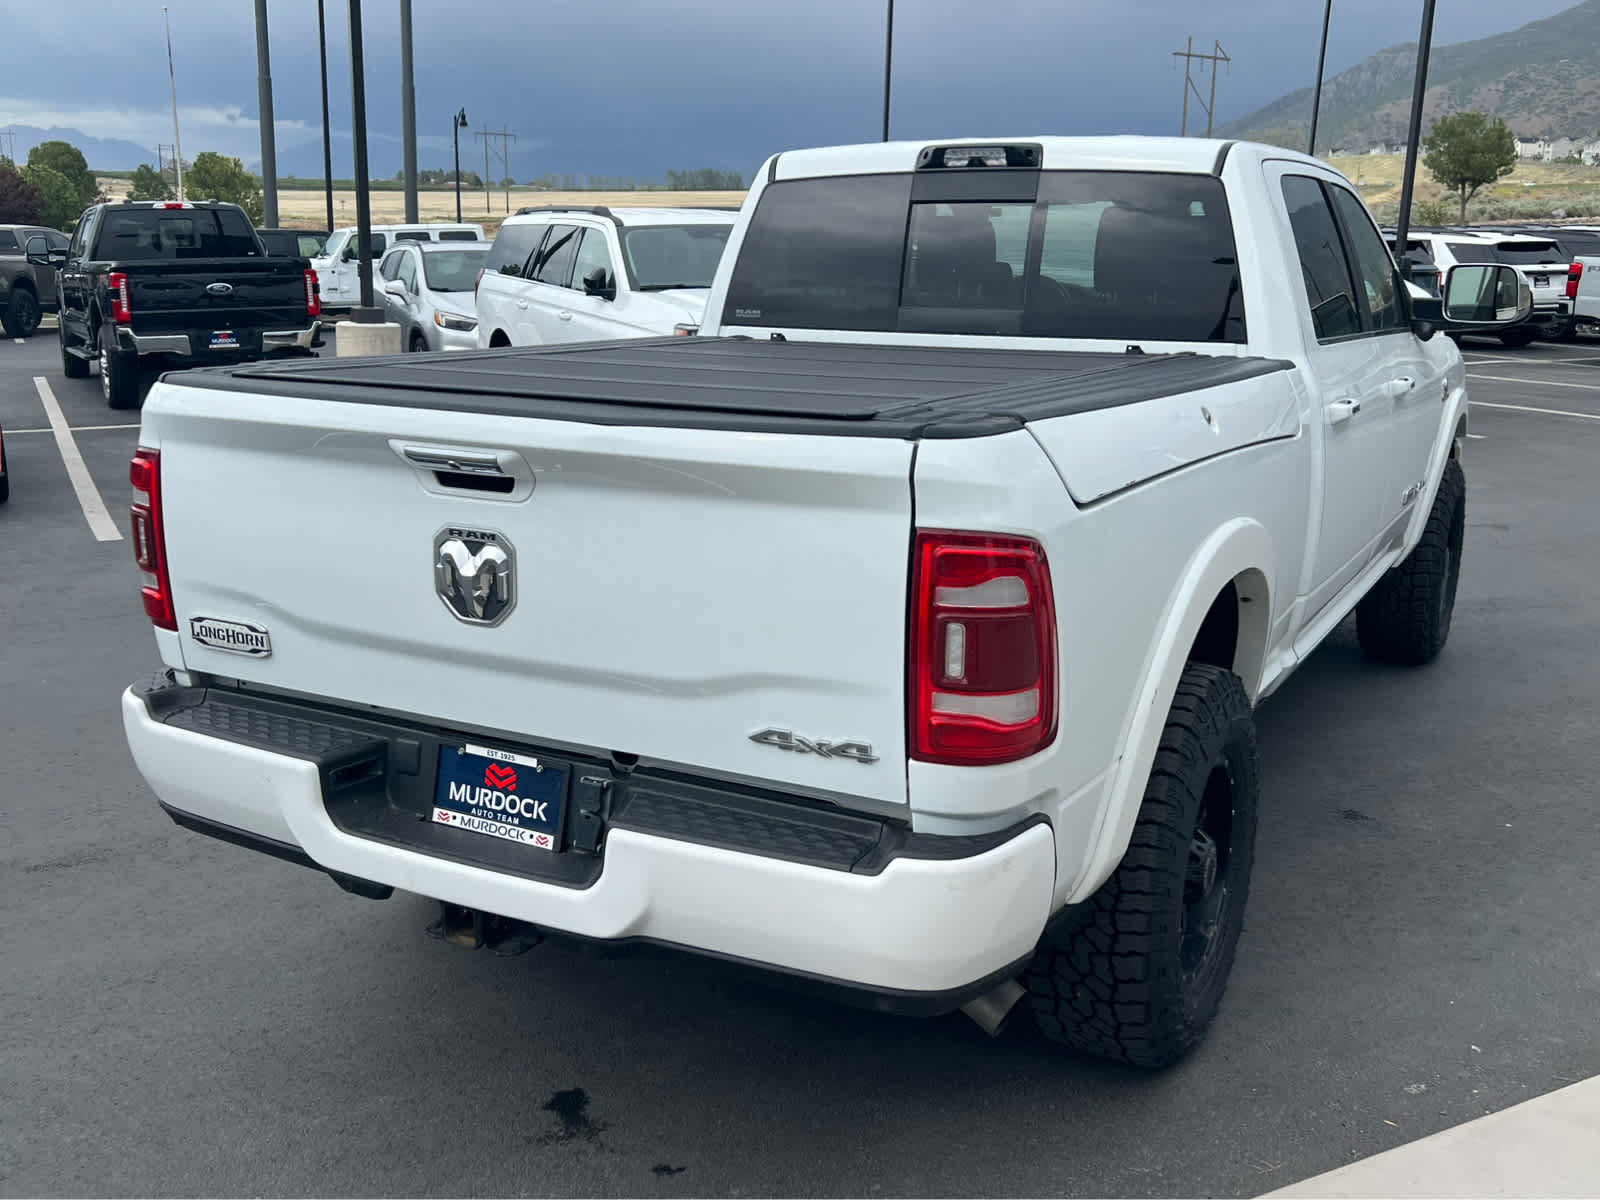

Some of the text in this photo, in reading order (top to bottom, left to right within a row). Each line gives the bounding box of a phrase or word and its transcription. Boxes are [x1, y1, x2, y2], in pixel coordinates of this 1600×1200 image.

[448, 528, 497, 541] RAM
[190, 622, 265, 647] LONGHORN
[486, 749, 516, 761] EST 1925
[448, 780, 548, 822] MURDOCK
[471, 807, 520, 825] AUTO TEAM
[460, 816, 527, 841] MURDOCK
